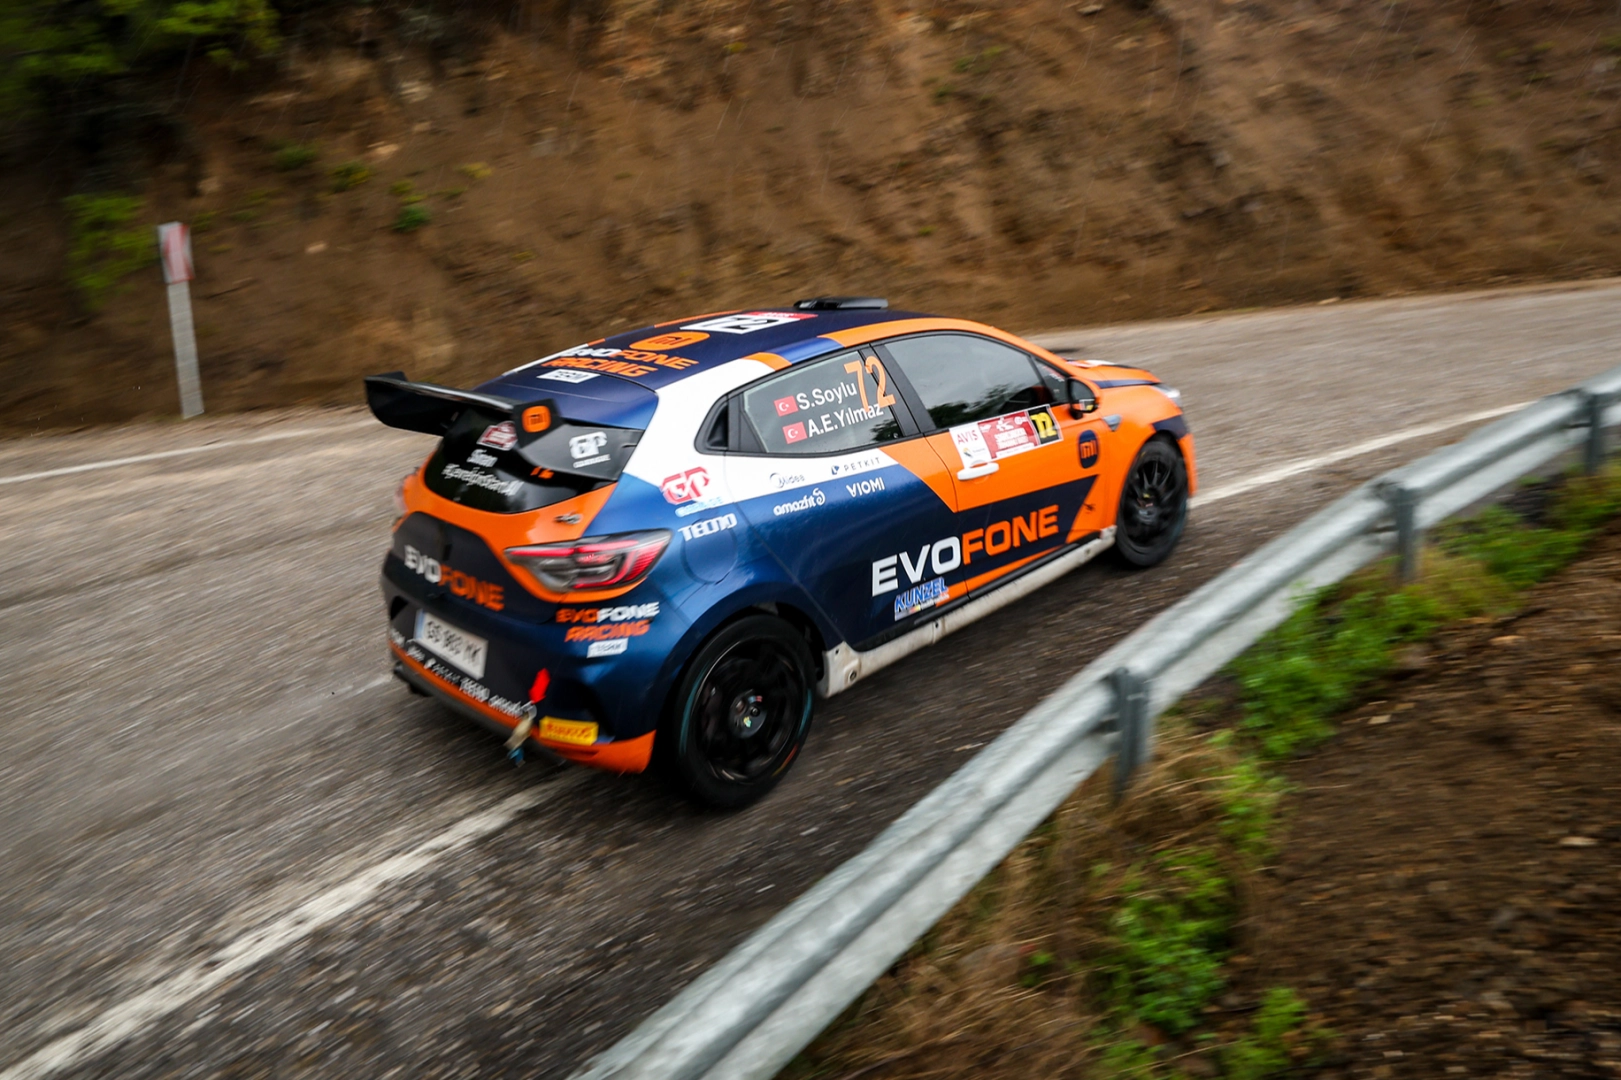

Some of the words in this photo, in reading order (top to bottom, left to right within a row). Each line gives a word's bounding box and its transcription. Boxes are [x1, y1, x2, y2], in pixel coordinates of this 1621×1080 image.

[796, 382, 857, 410] S.Soylu
[843, 356, 896, 413] 72
[957, 429, 979, 445] AVIS
[844, 457, 880, 472] PETKIT
[846, 477, 885, 498] VIOMI
[773, 490, 820, 516] amazfit
[871, 504, 1059, 597] EVOFONE
[404, 544, 505, 612] EVOFONE
[894, 576, 948, 613] KUNZEL
[555, 601, 660, 623] EVOFONE
